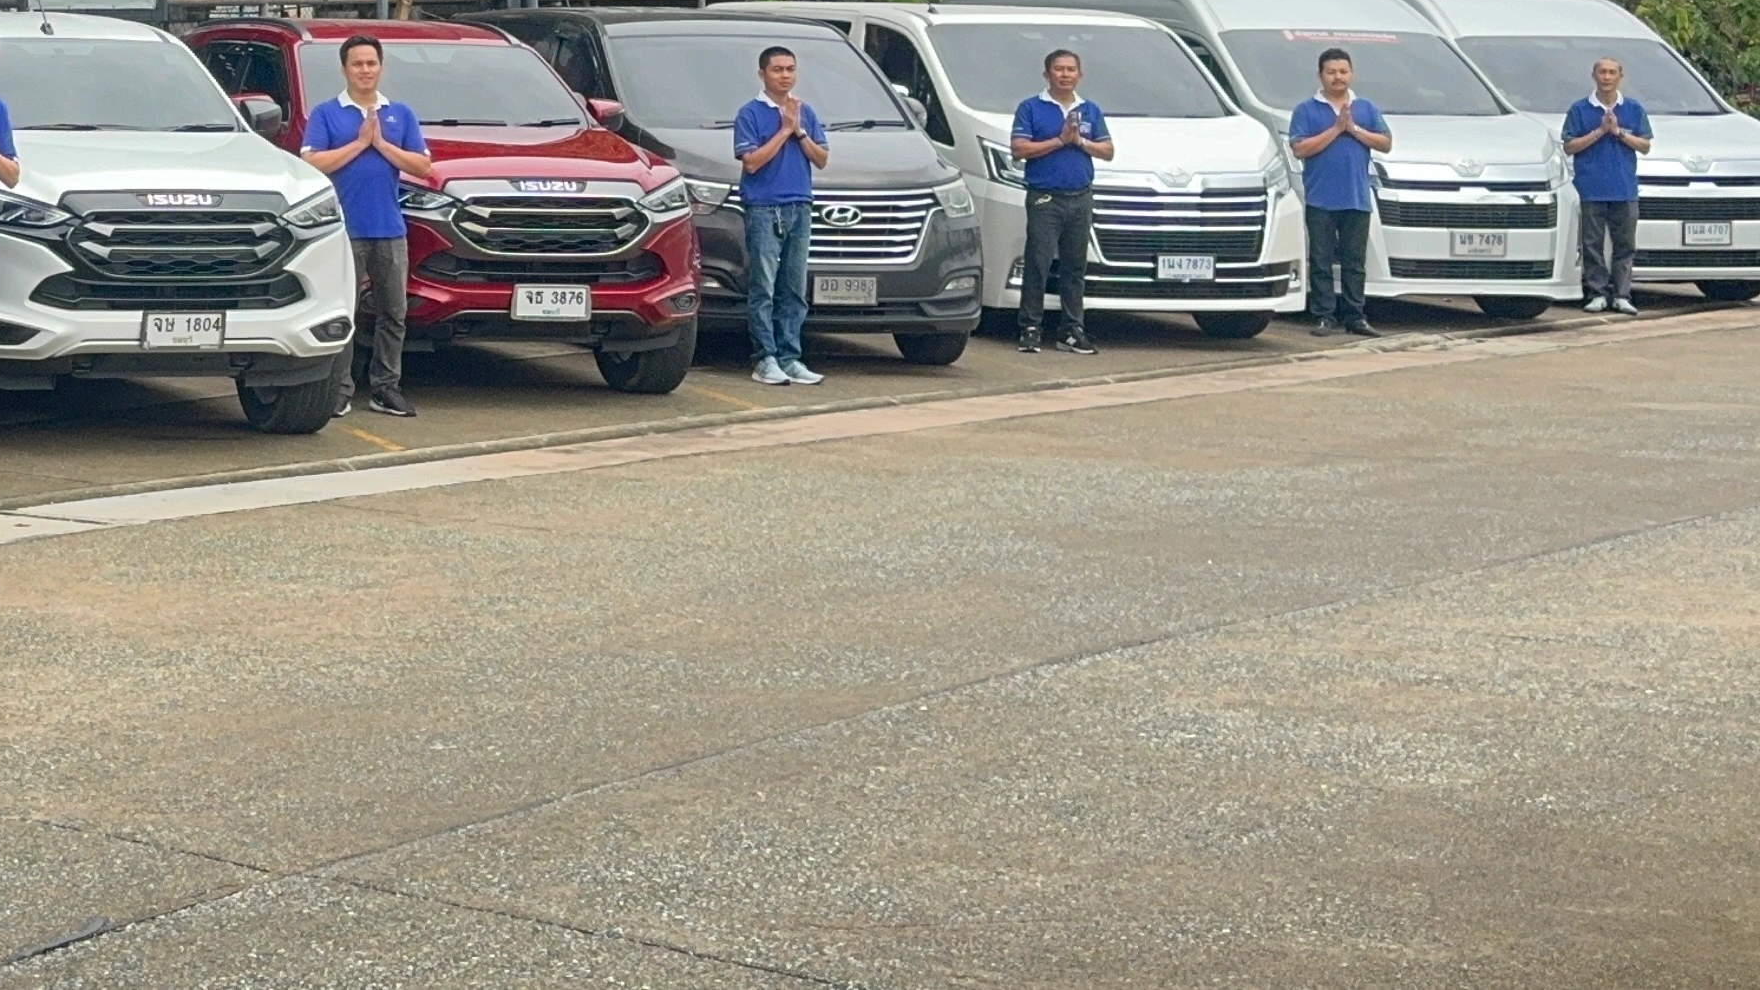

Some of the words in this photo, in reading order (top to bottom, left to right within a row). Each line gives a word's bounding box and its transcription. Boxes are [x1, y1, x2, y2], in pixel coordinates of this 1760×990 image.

[519, 180, 577, 191] ISUZU
[146, 193, 213, 205] ISUZU
[550, 291, 584, 305] 3876
[185, 317, 222, 332] 1804
